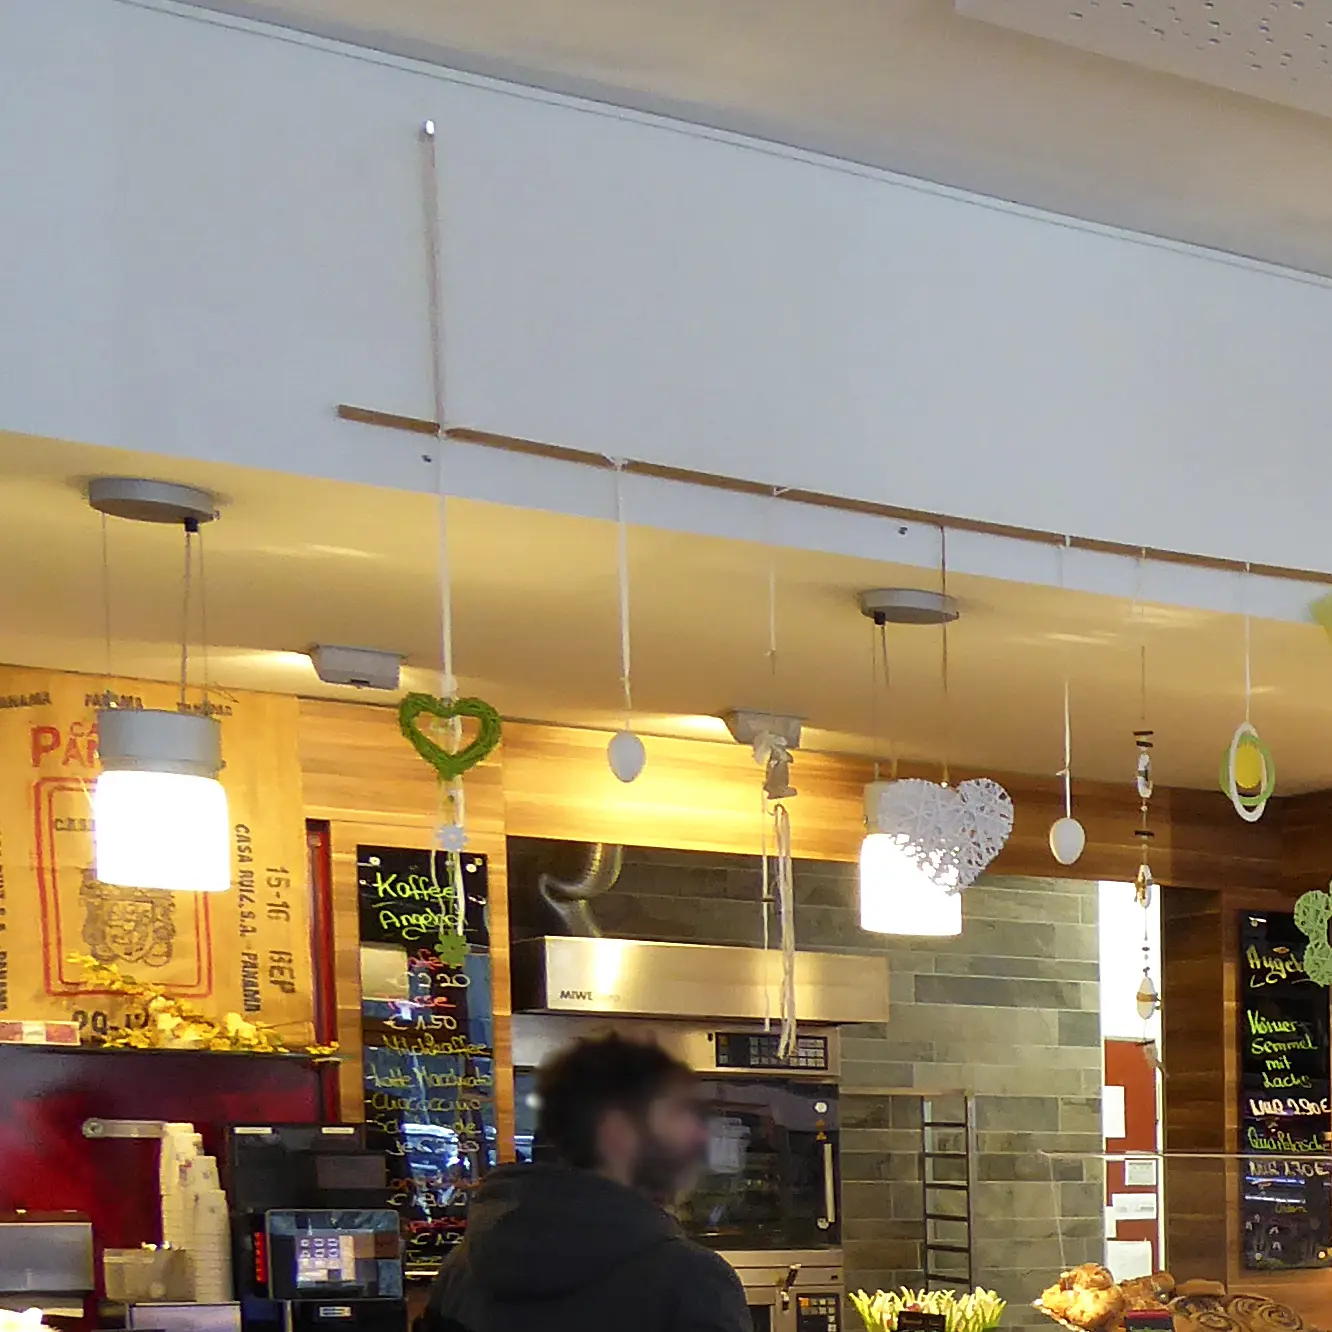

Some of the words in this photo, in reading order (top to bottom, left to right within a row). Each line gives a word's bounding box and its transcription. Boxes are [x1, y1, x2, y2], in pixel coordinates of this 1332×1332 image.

[235, 823, 253, 864] CASA
[374, 871, 461, 901] Kaffee
[241, 951, 262, 1013] PANAMA
[1251, 1033, 1319, 1055] Semmel
[1265, 1055, 1292, 1071] mit
[1261, 1071, 1313, 1089] Lachs
[1250, 1099, 1287, 1117] NUR
